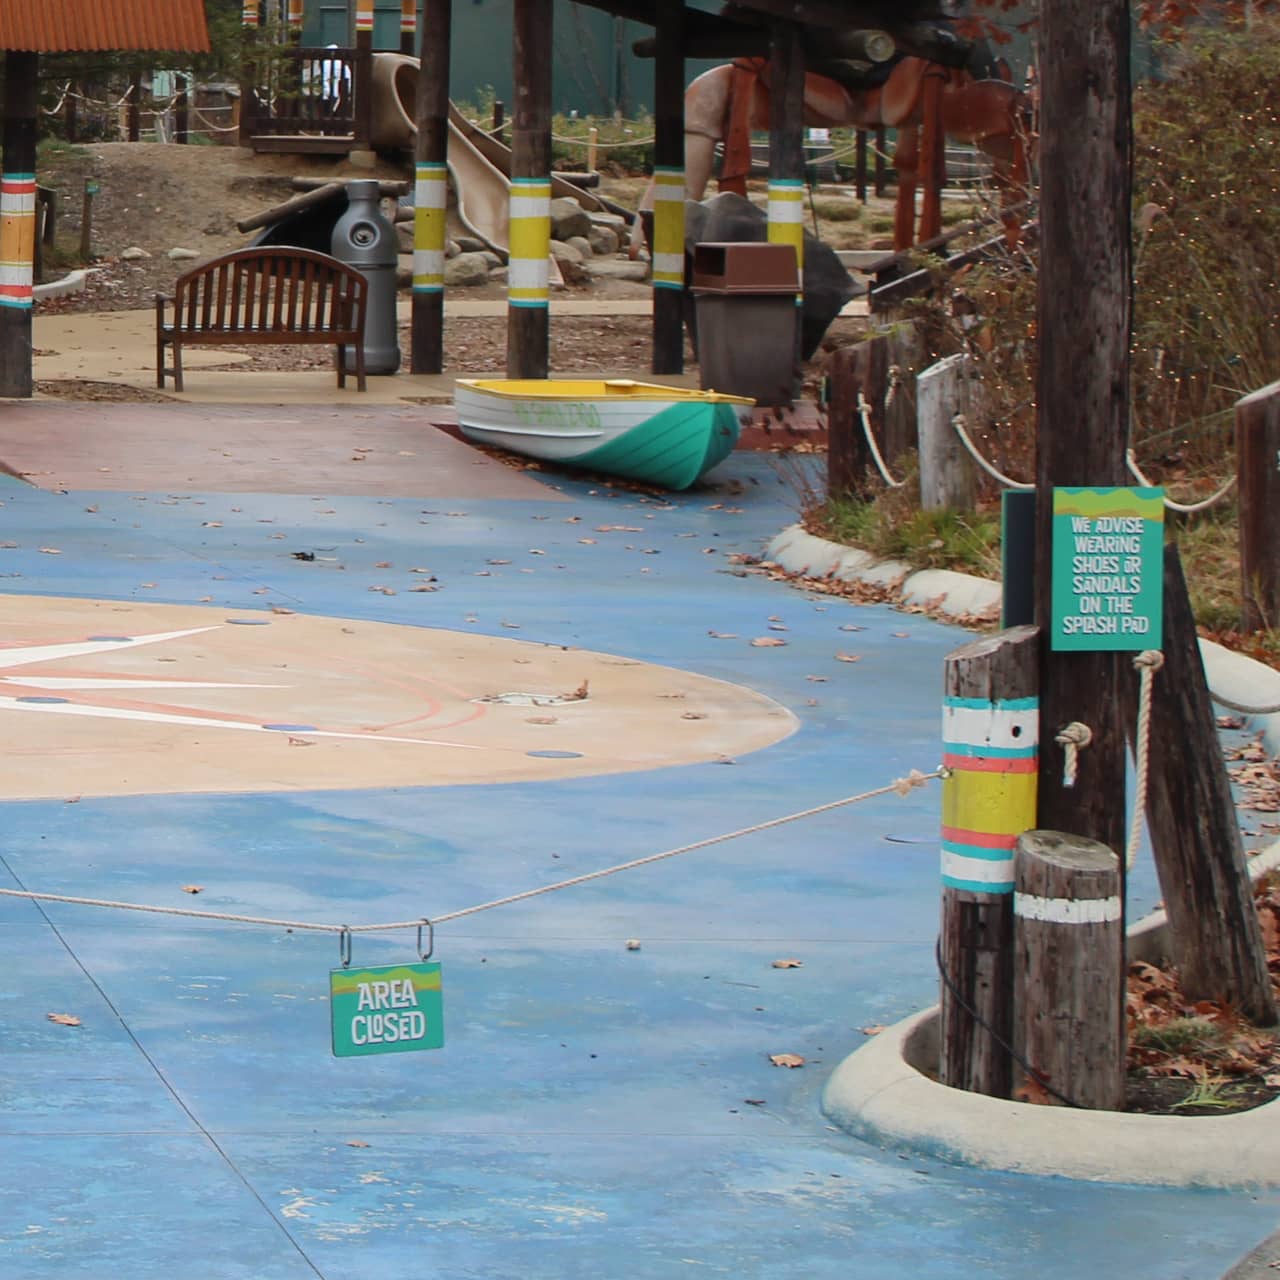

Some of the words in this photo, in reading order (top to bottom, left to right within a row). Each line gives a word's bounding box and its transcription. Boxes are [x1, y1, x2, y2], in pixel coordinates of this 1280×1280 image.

[1071, 517, 1091, 533] WE
[1095, 517, 1145, 534] ADVISE
[1074, 536, 1141, 553] WEARING
[1072, 556, 1120, 573] SHOES
[1124, 556, 1142, 573] OR
[1072, 576, 1142, 593] SANDALS
[1080, 596, 1101, 613] ON
[1105, 596, 1134, 613] THE
[1062, 616, 1117, 634] SPLASH
[1121, 616, 1149, 633] PAD
[357, 978, 419, 1012] AREA
[351, 1011, 426, 1045] CLOSED
